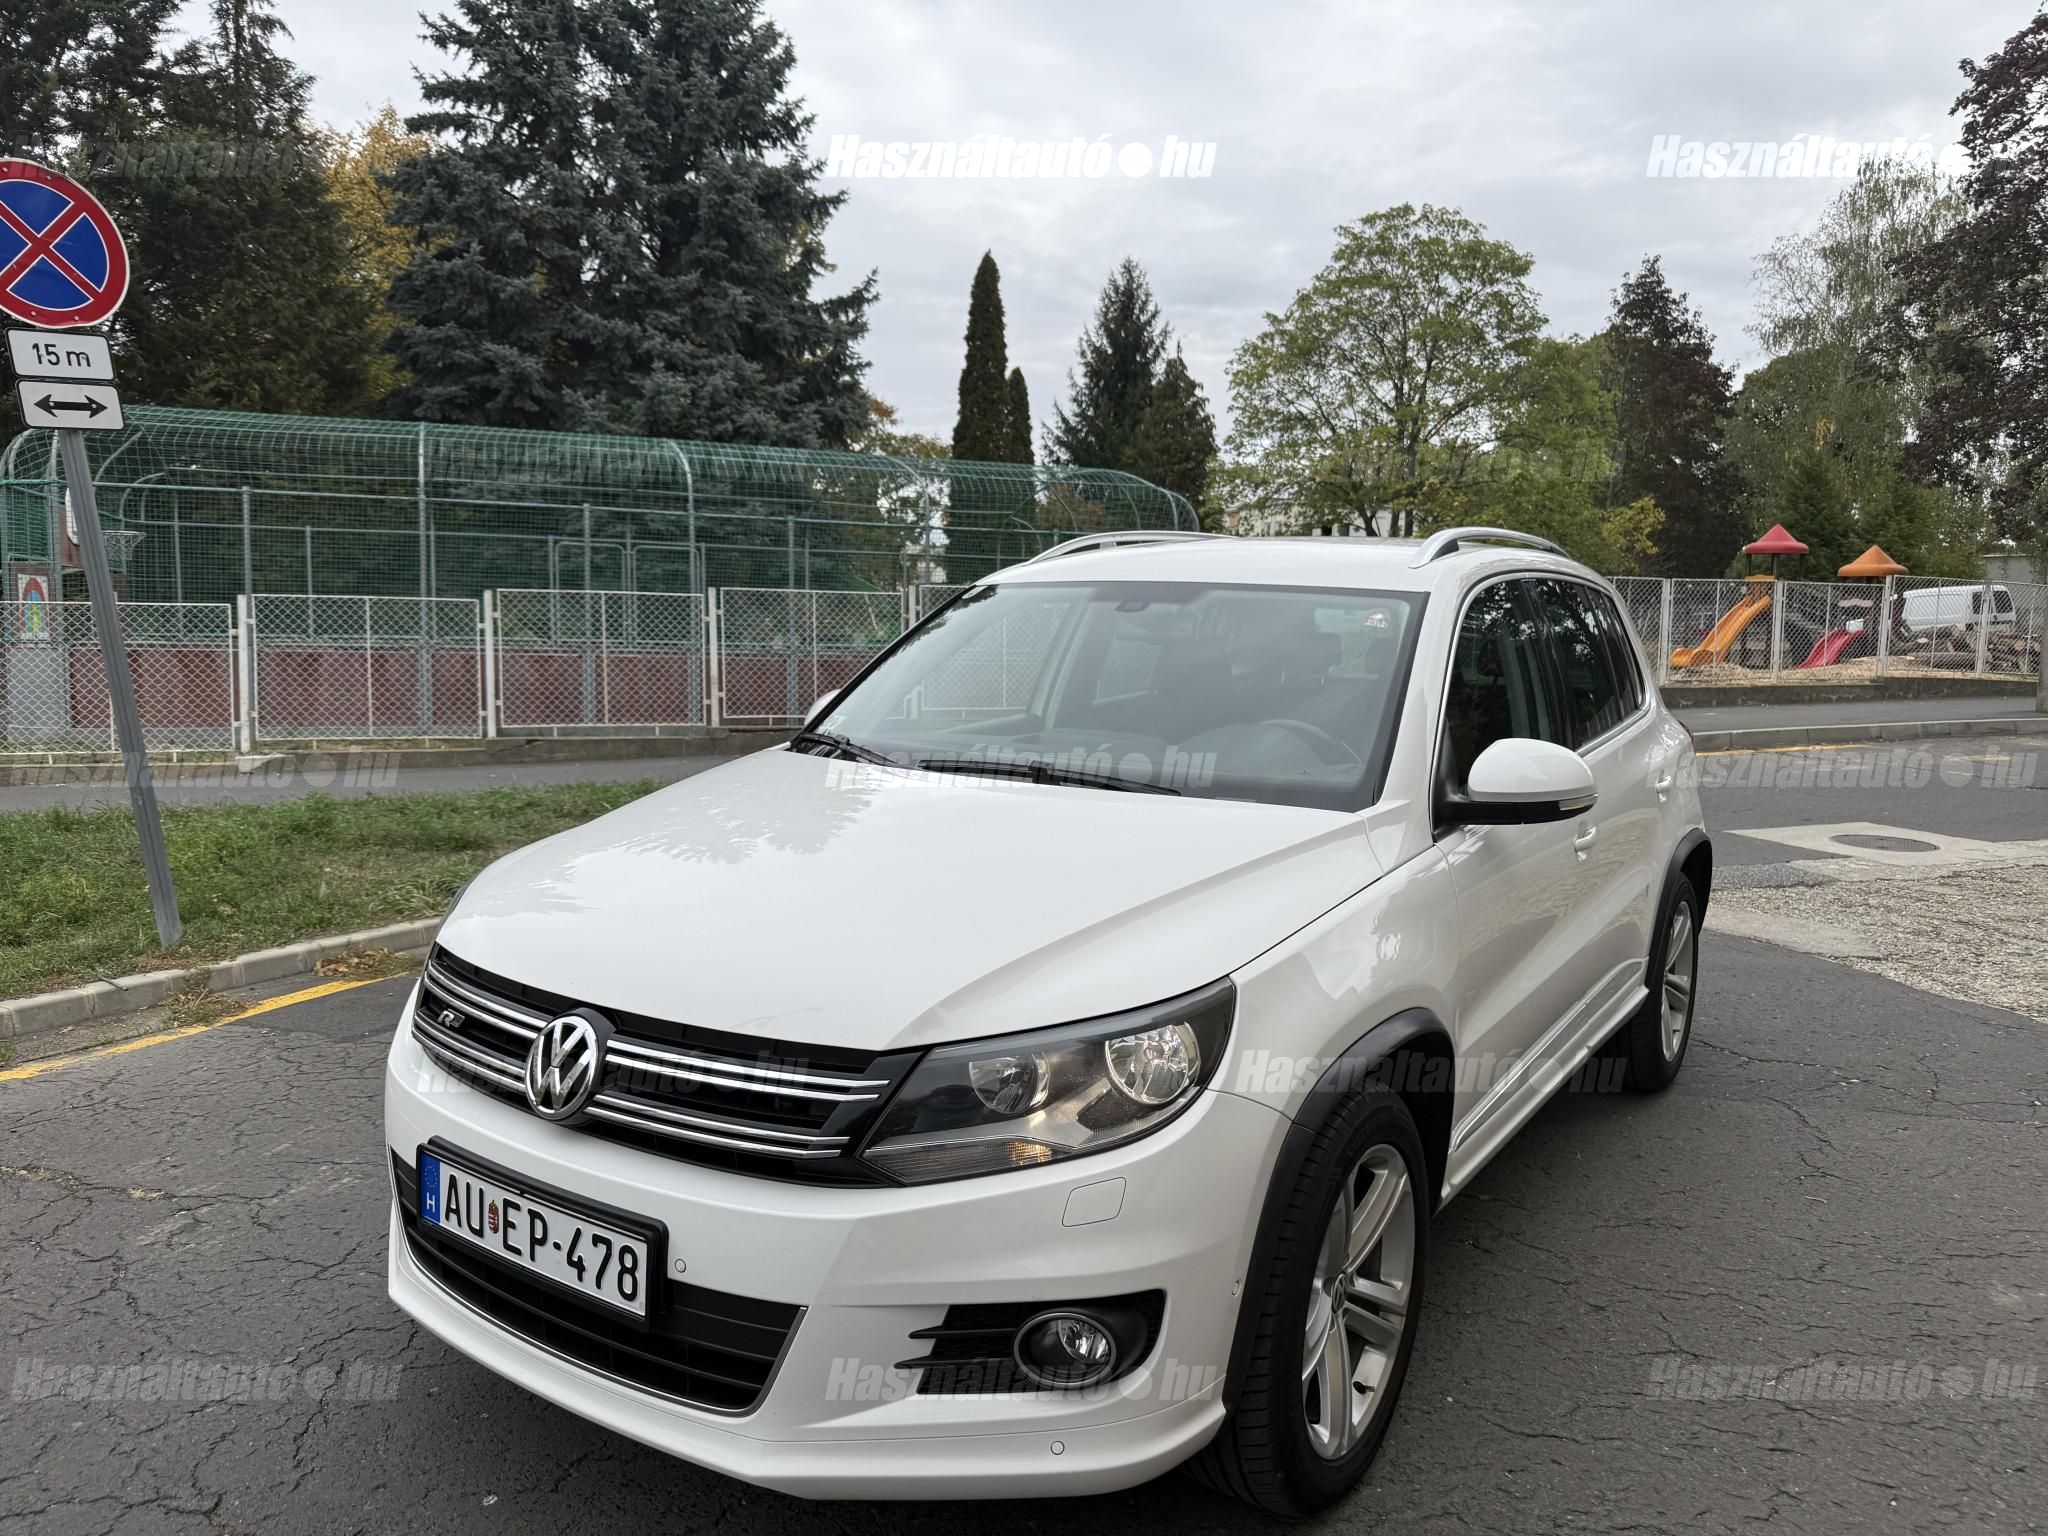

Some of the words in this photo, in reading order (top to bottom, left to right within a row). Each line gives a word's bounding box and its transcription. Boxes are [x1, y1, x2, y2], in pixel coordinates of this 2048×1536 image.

[32, 343, 60, 365] 15
[66, 351, 91, 367] m
[426, 1192, 435, 1213] H
